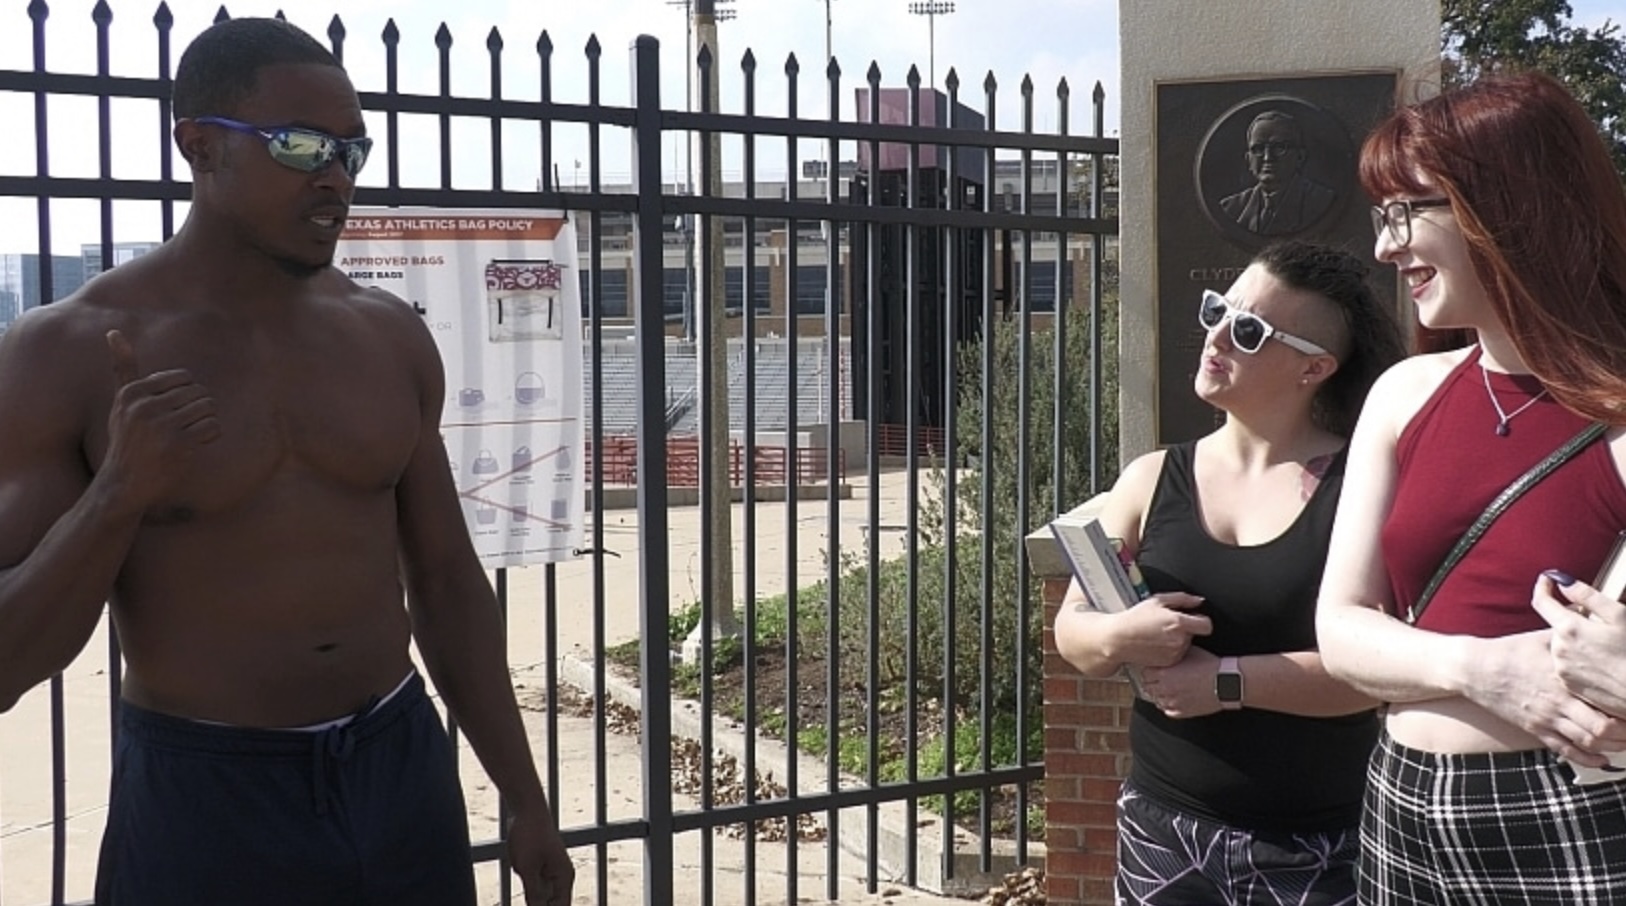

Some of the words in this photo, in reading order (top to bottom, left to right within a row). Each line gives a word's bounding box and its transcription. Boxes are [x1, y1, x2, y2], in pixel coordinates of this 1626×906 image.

[345, 219, 382, 230] EXAS
[384, 219, 456, 230] ATHLETICS
[458, 220, 486, 230] BAG
[488, 220, 534, 230] POLICY
[341, 257, 408, 266] APPROVED
[411, 256, 444, 265] BAGS
[348, 271, 373, 279] ARGE
[376, 271, 404, 279] BAGS
